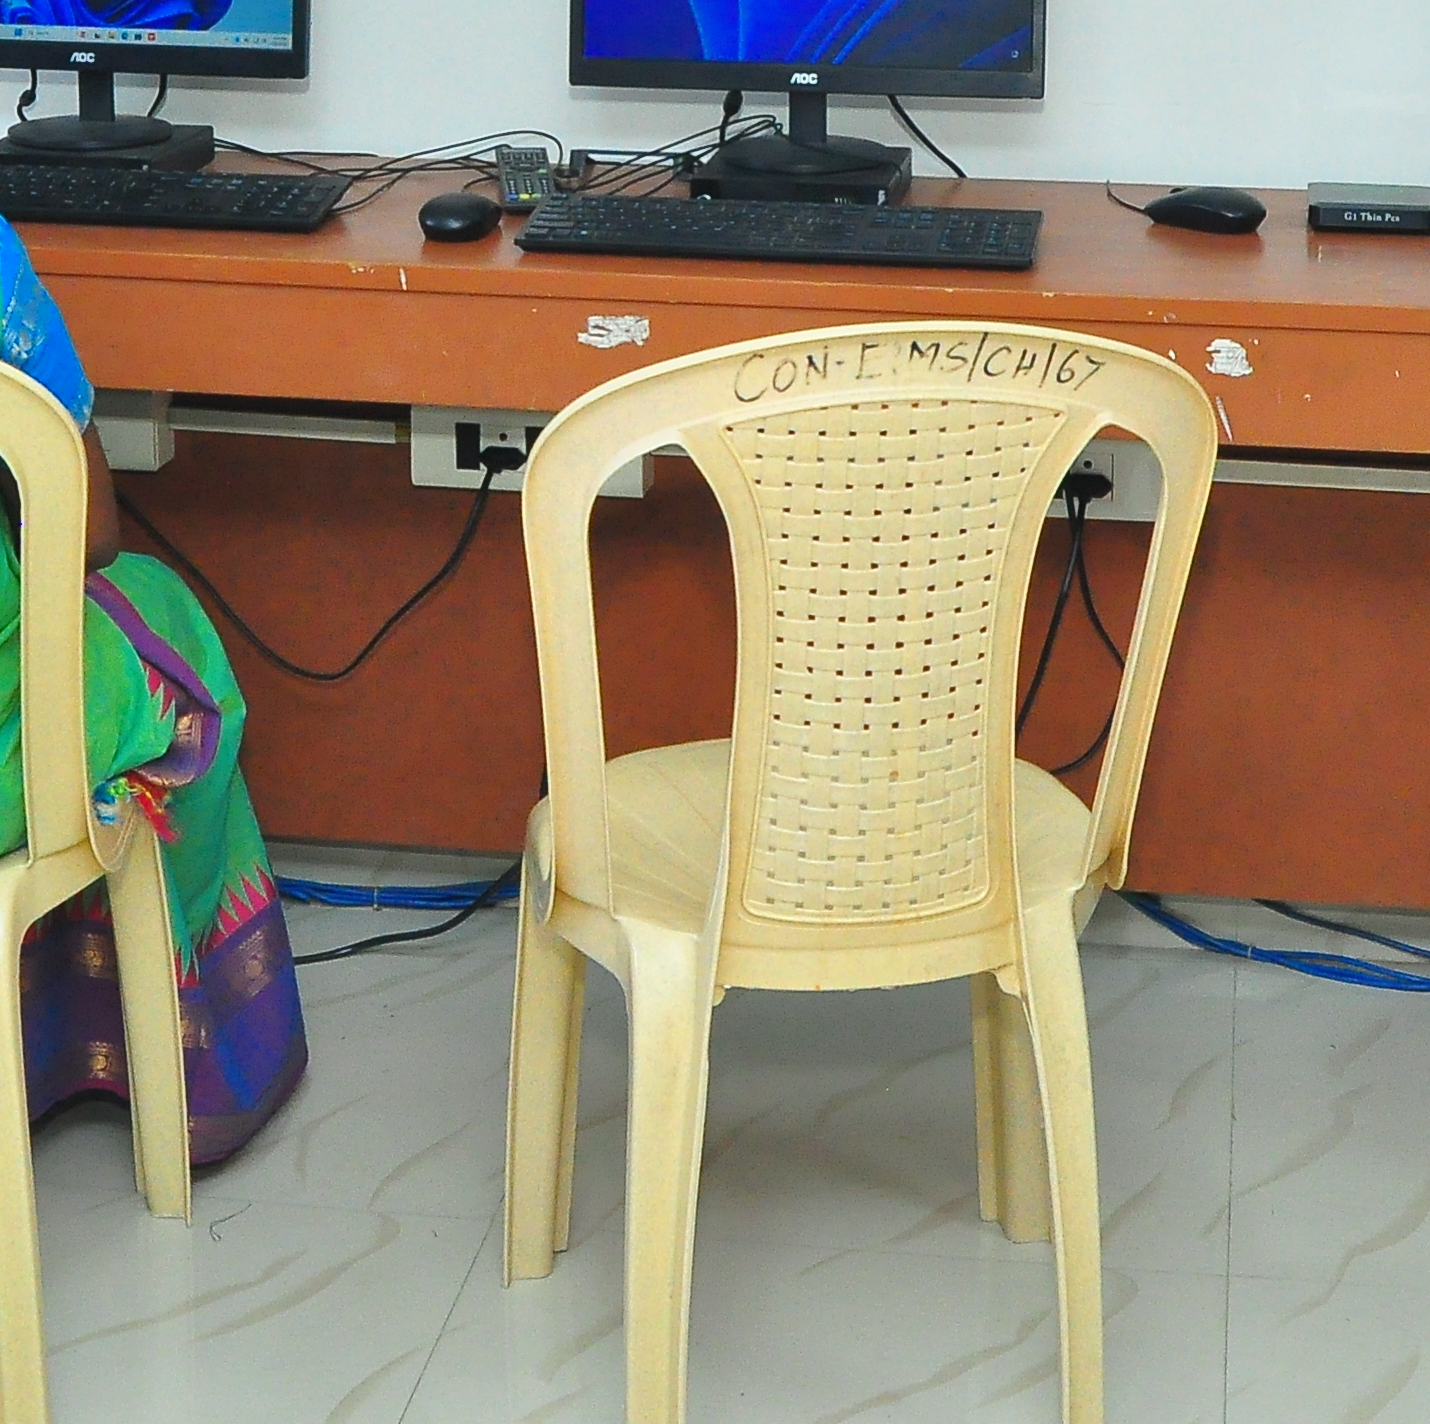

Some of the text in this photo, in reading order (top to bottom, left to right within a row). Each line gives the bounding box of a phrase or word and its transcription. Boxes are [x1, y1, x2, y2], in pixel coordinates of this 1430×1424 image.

[70, 51, 96, 63] AOC
[790, 72, 818, 84] AOC
[1344, 211, 1357, 221] G1
[1360, 212, 1382, 222] Thin
